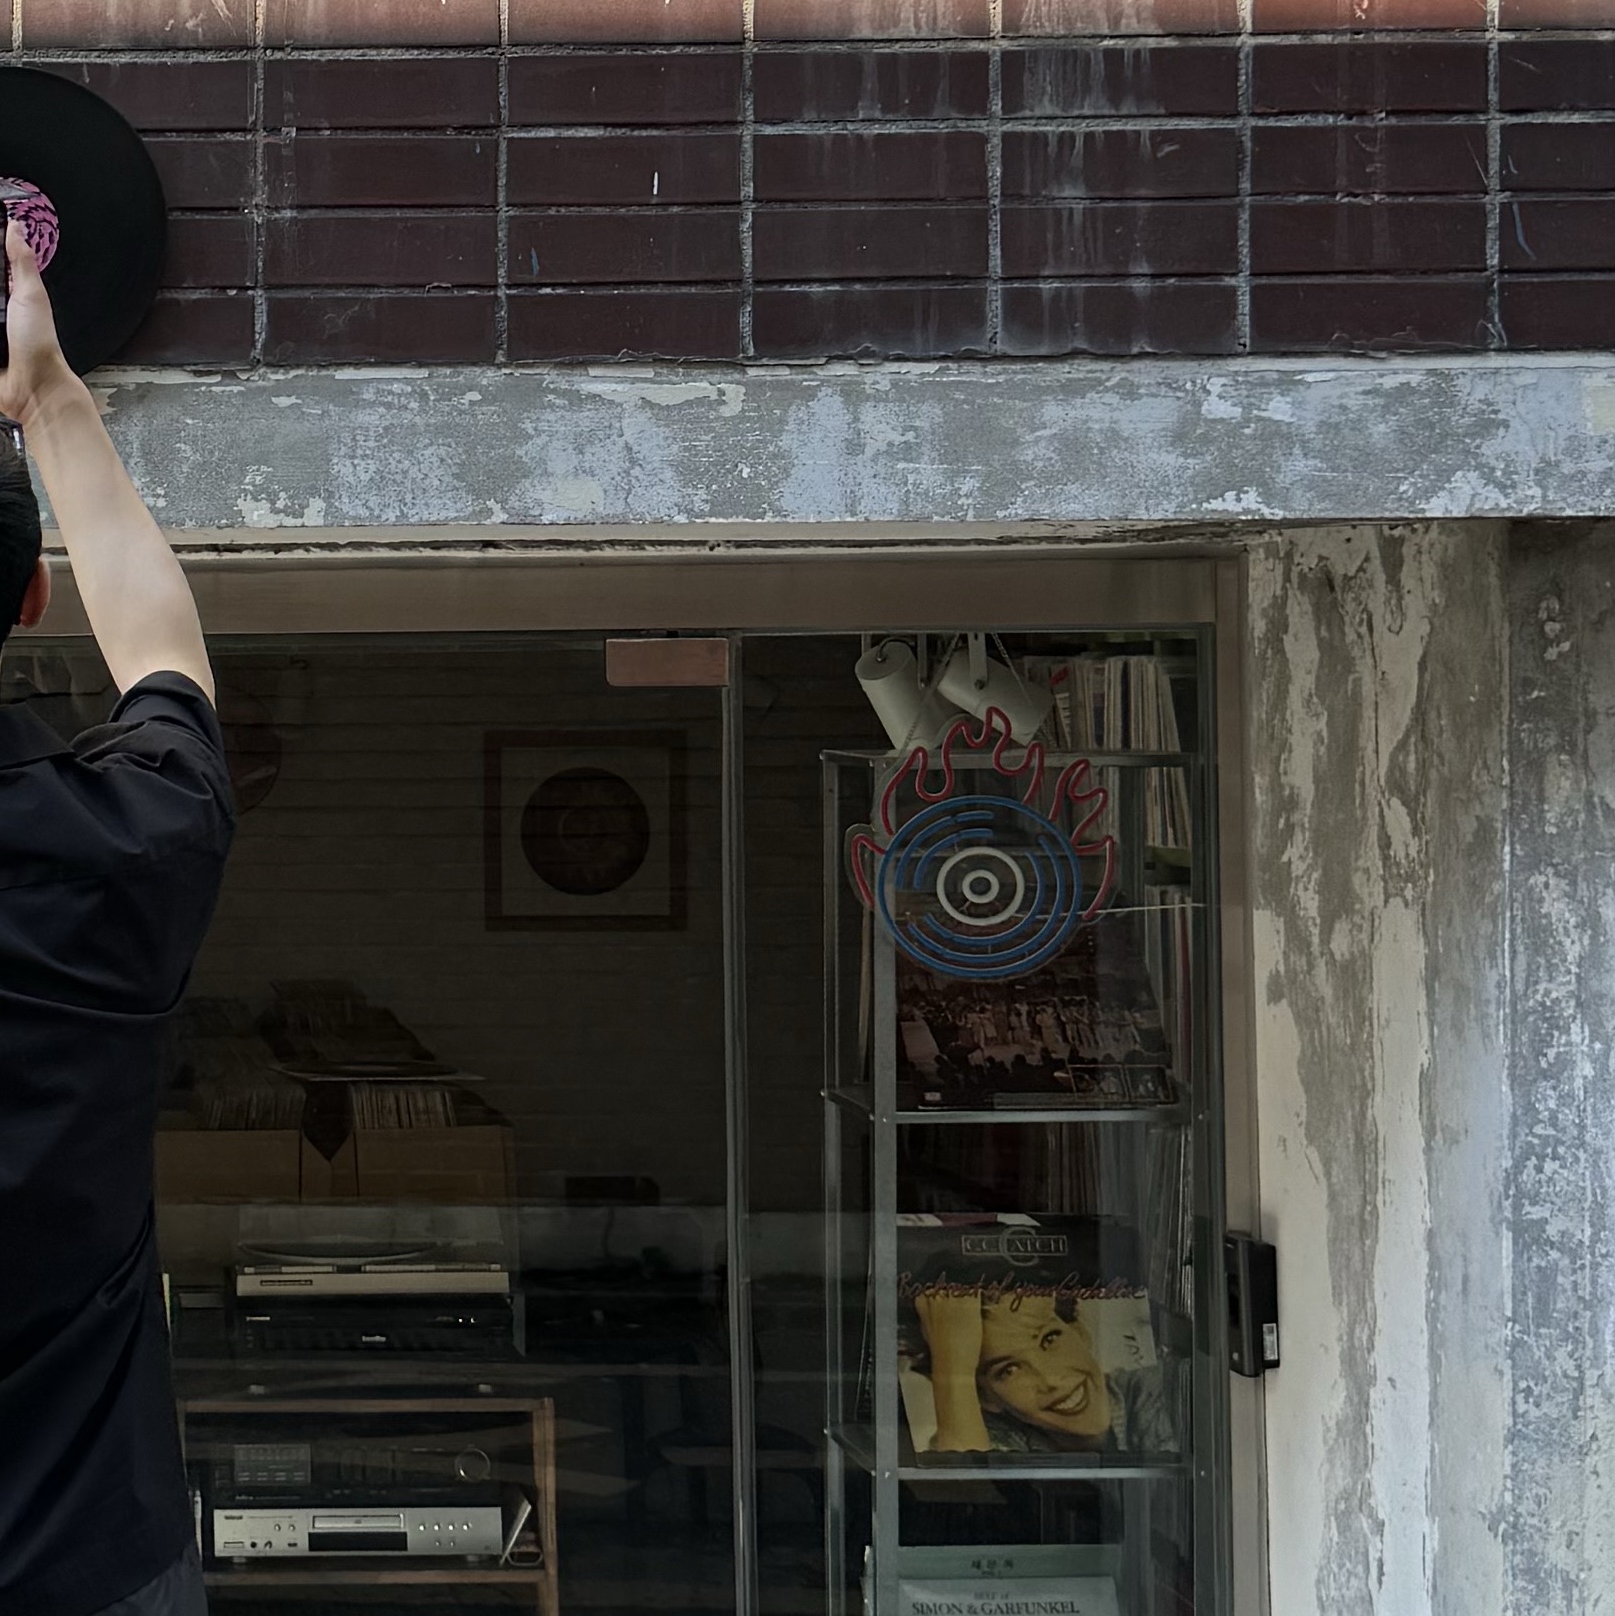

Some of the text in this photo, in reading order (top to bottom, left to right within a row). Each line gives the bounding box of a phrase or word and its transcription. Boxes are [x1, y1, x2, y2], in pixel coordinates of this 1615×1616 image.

[911, 1600, 1080, 1616] SIMON & GARFUNKEL
